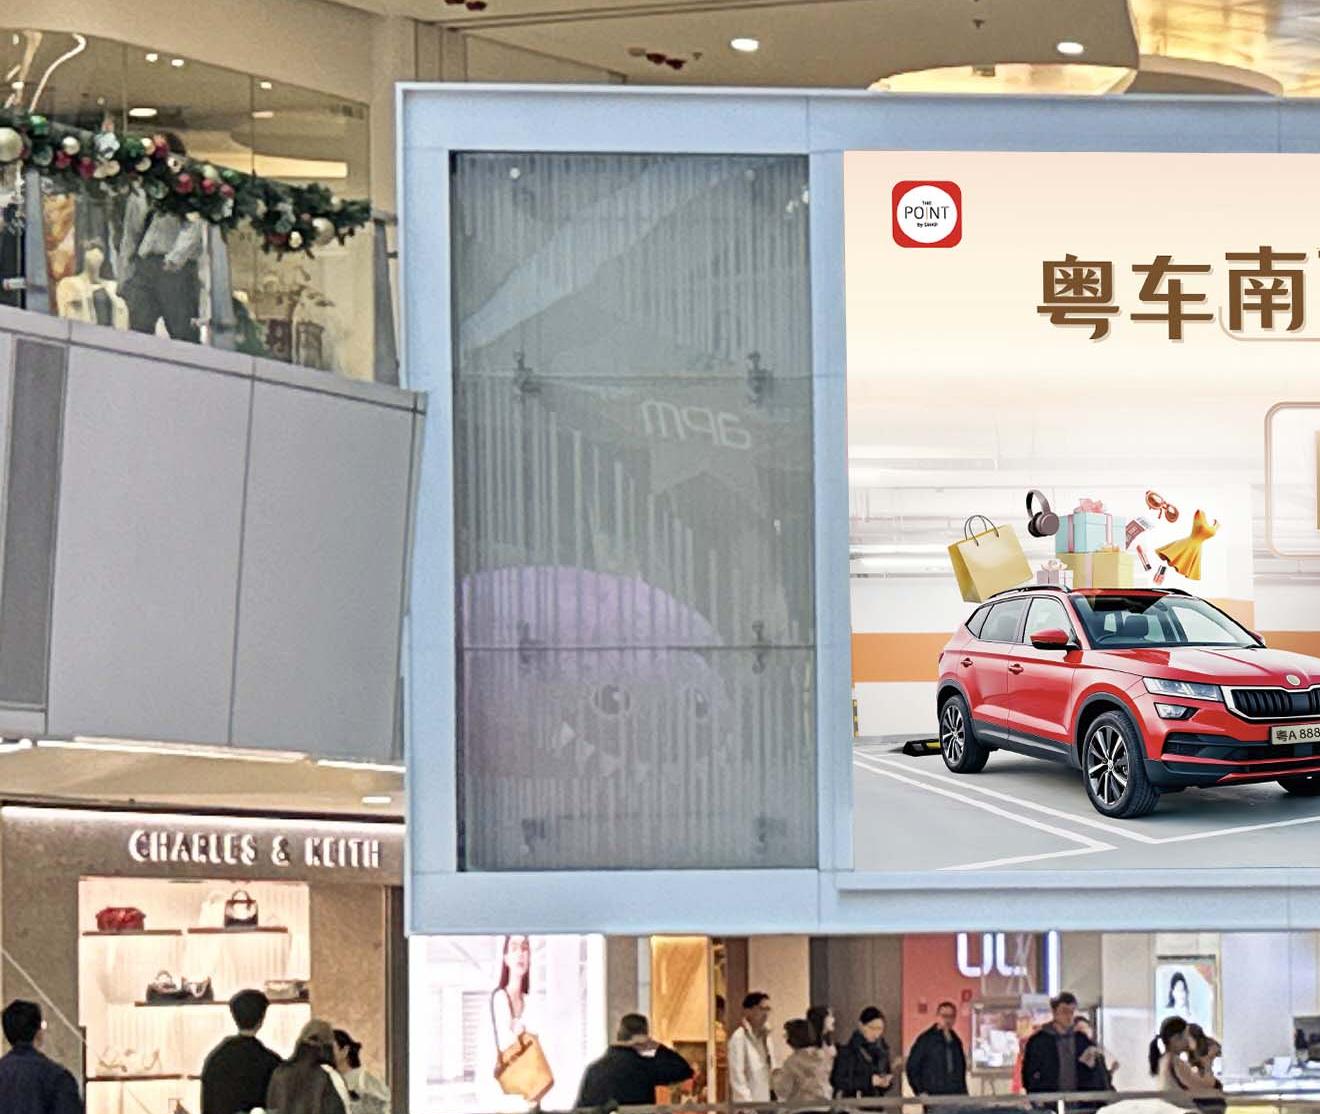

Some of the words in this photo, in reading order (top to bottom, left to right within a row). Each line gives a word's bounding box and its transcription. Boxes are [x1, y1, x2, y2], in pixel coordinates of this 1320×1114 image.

[904, 206, 949, 220] POINT
[128, 829, 257, 867] CHARLES
[271, 835, 290, 867] &
[304, 836, 380, 869] KEITH
